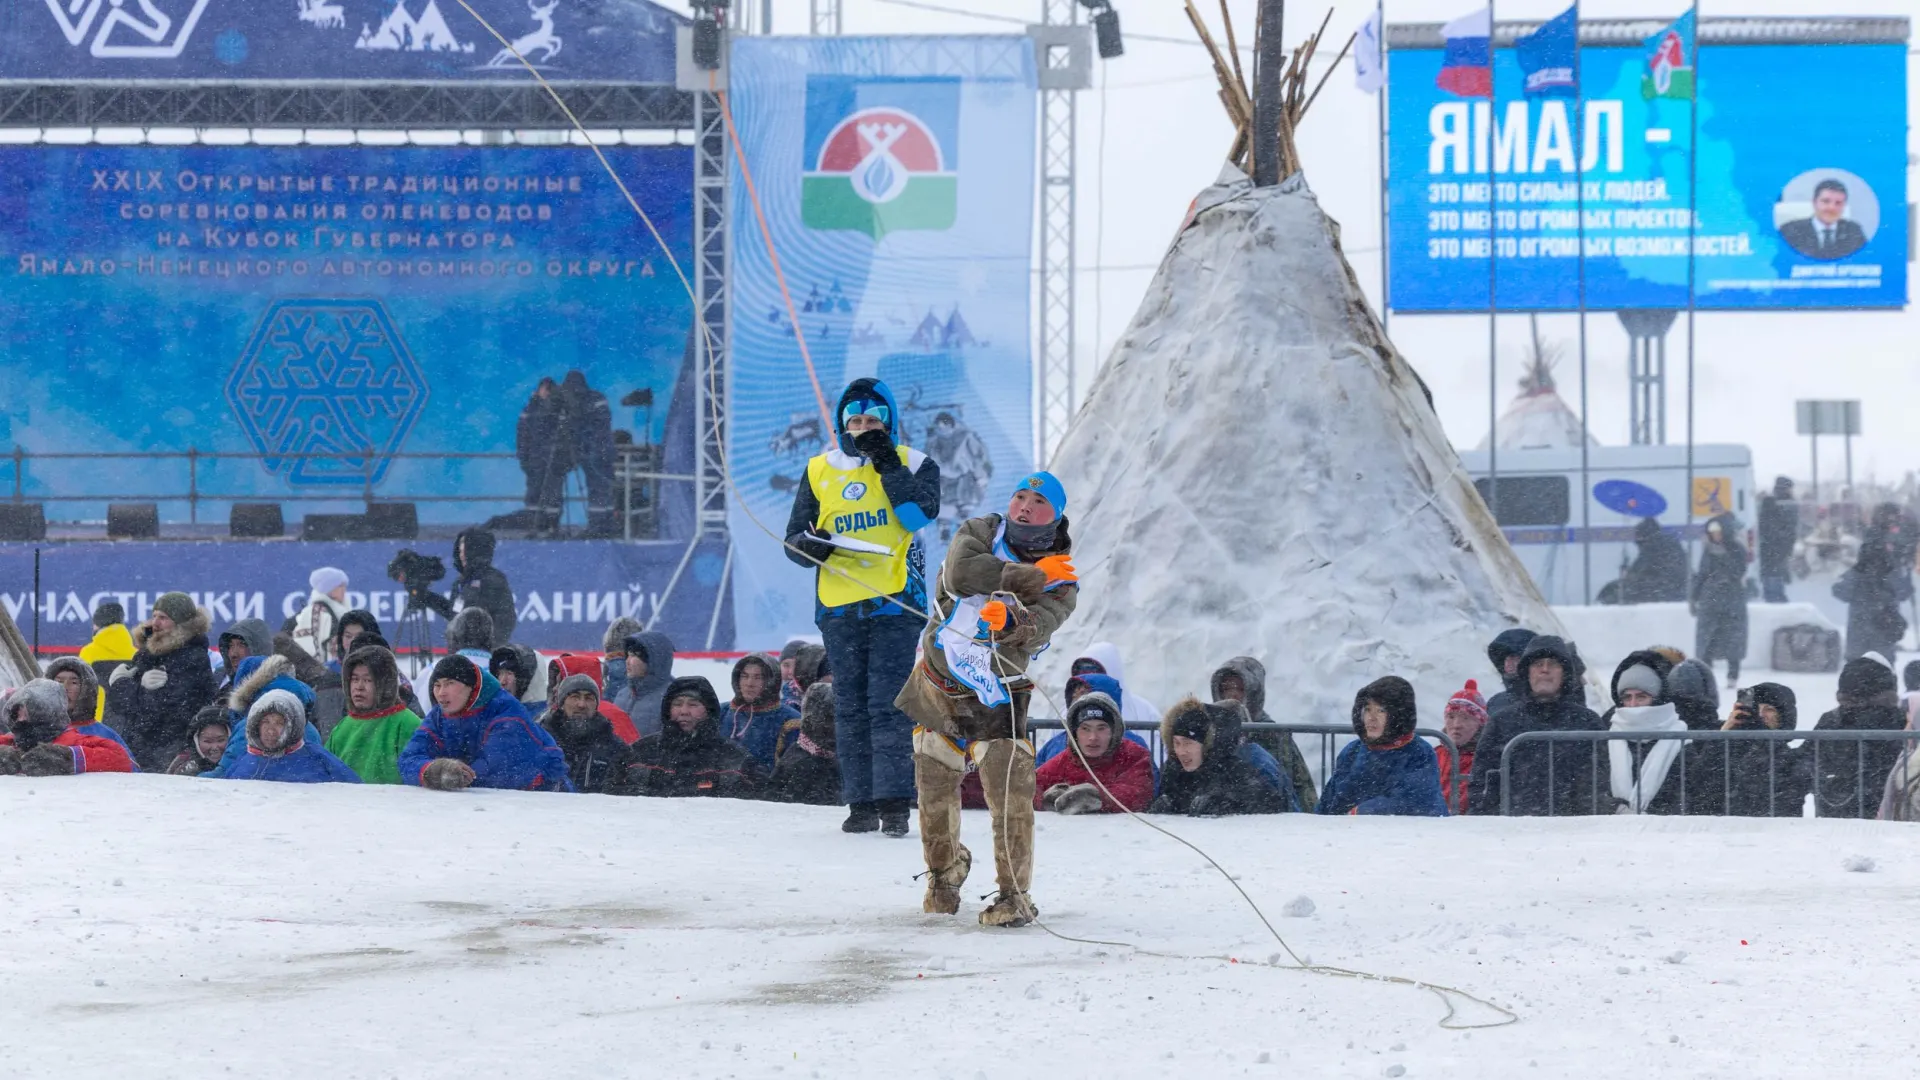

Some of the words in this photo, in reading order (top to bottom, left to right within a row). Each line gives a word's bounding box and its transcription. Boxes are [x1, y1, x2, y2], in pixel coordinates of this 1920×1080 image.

[1428, 100, 1624, 174] ЯМАЛ
[92, 170, 164, 191] XXIX
[347, 175, 582, 195] ТРАДИЦИОННЫЕ
[1428, 182, 1460, 203] ЭТО
[119, 203, 347, 219] СОРЕВНОВАНИЯ
[361, 204, 552, 221] ОЛЕНЕВОДОВ
[1428, 210, 1460, 231] ЭТО
[1428, 238, 1460, 259] ЭТО
[834, 508, 889, 534] СУДЬЯ
[0, 590, 266, 623] УЧАСТНКИ
